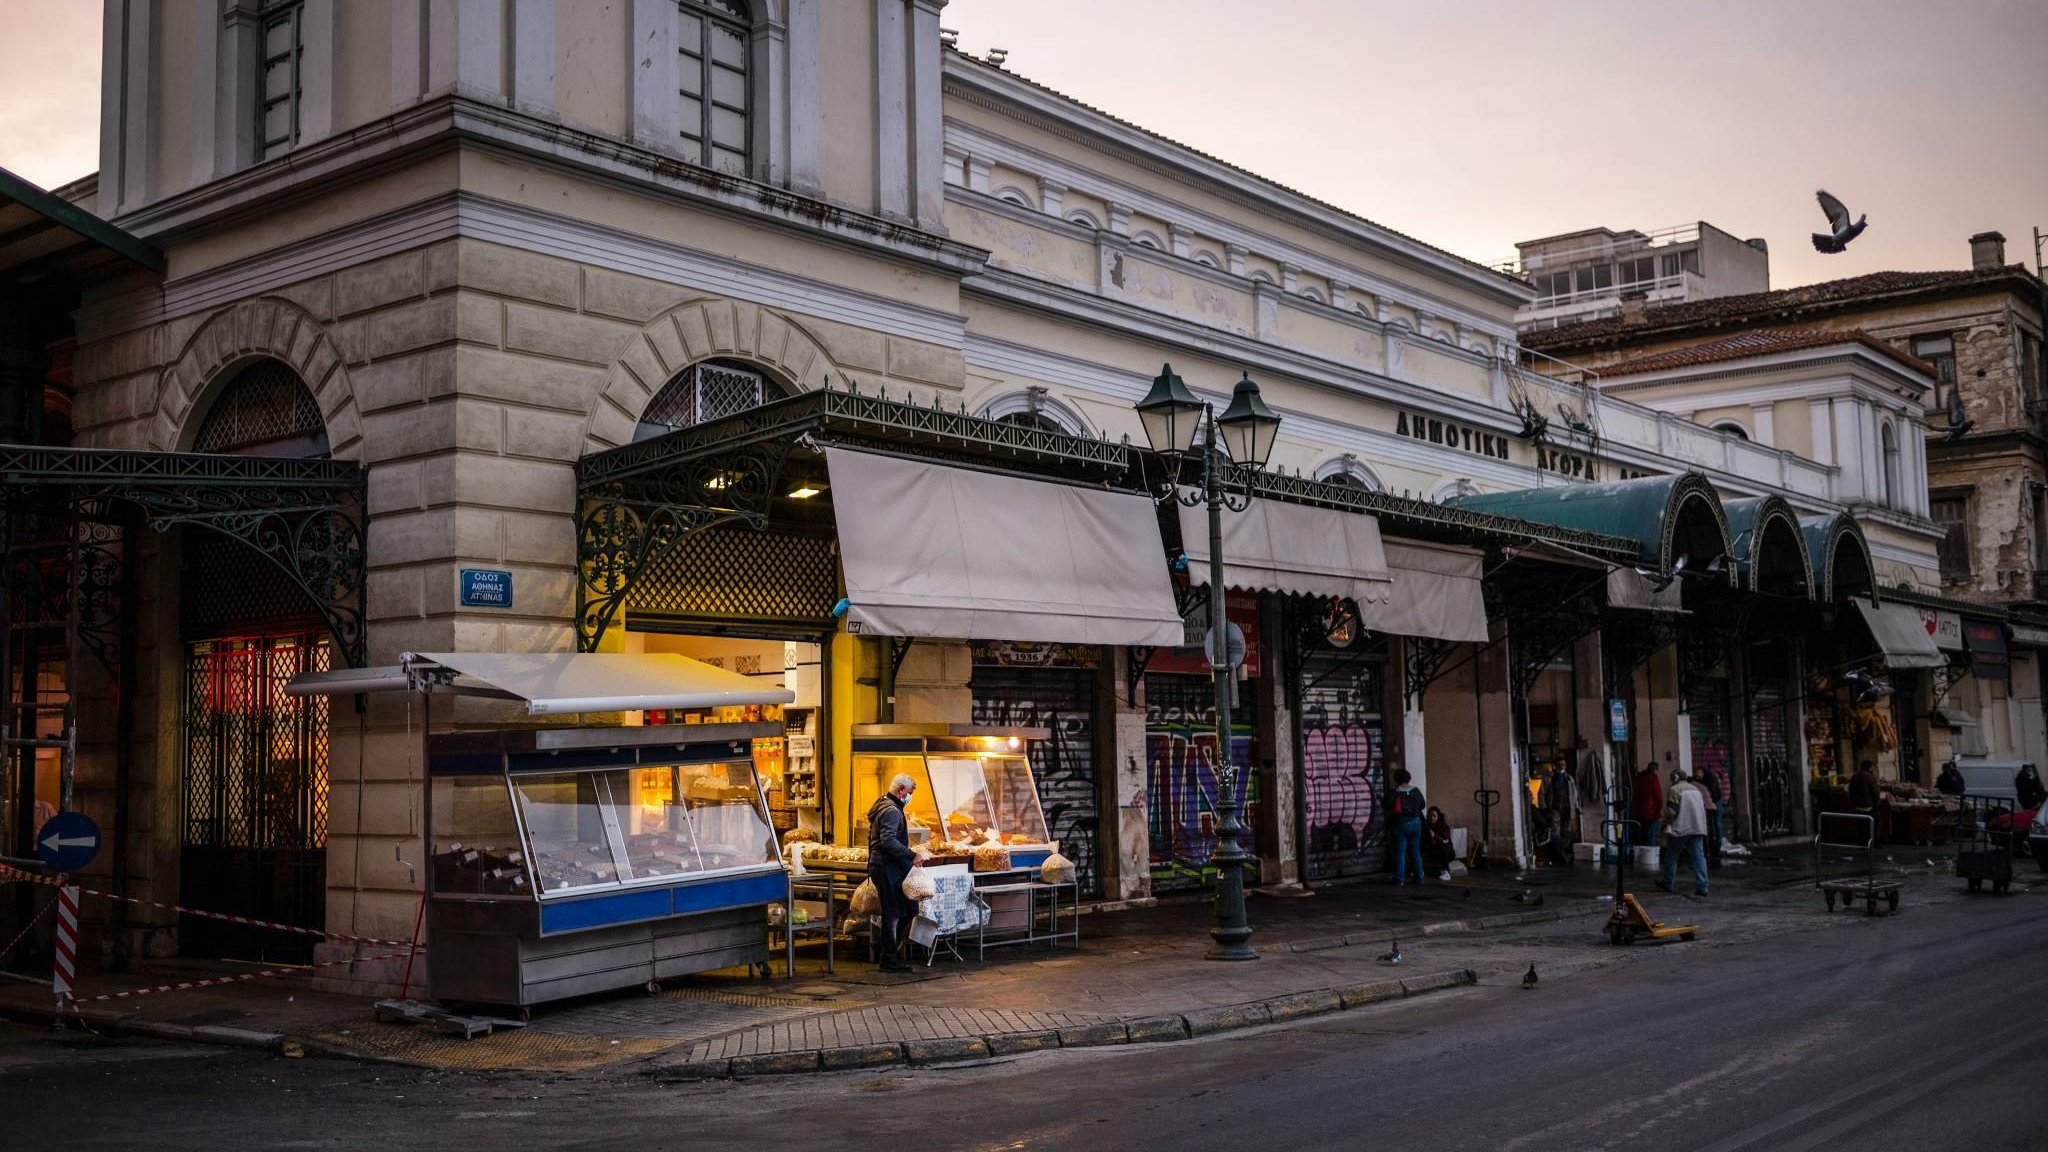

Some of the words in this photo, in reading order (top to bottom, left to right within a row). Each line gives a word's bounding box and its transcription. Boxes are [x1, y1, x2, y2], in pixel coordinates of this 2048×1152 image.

[1396, 411, 1509, 460] ΔΗΜΟΤΙΚΗ
[1538, 448, 1596, 481] ΑΓΟΡΑ
[474, 573, 499, 581] ΟΔΟΣ
[471, 582, 504, 592] ΑΘΗΝΑΣ
[471, 592, 504, 601] ATHINAS
[1015, 653, 1038, 661] 1936
